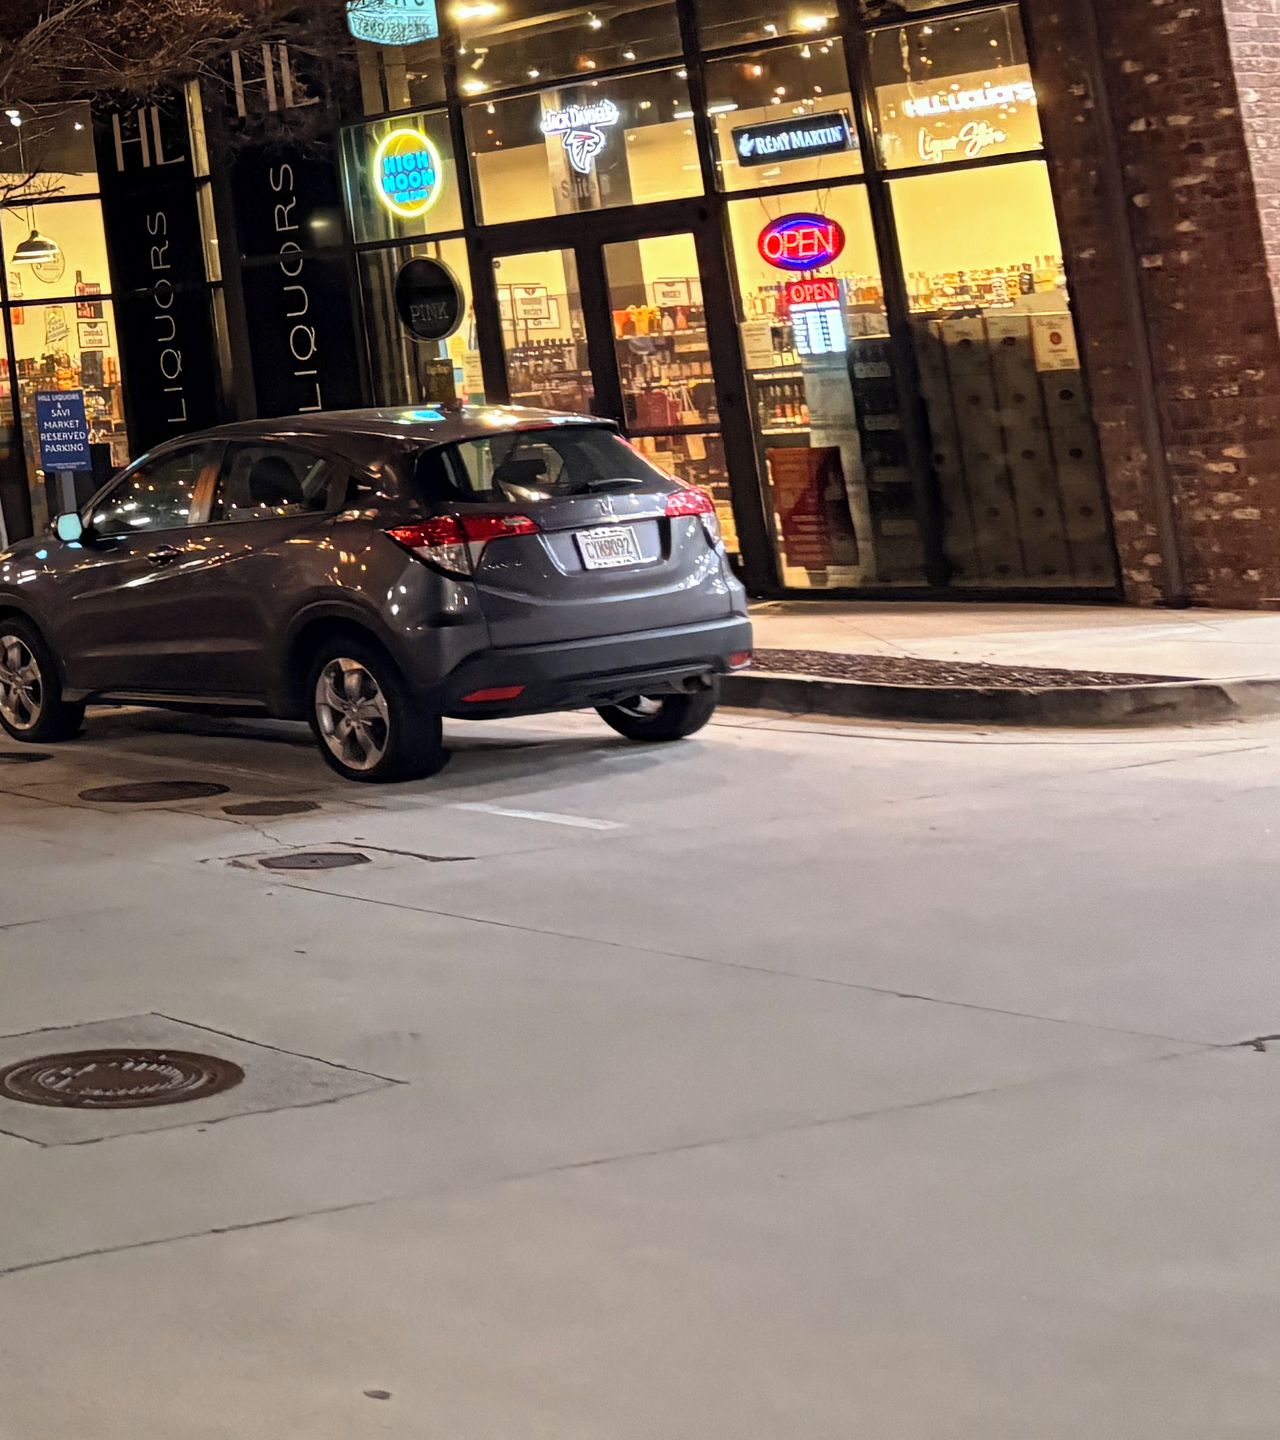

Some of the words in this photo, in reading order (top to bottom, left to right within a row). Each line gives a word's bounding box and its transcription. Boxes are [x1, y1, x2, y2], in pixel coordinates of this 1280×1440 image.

[112, 105, 185, 172] HL
[789, 125, 842, 149] MARTIN
[383, 150, 429, 175] HIGH
[382, 168, 435, 193] NOON
[763, 224, 835, 259] OPEN
[270, 163, 322, 412] LIQUORS
[791, 281, 837, 303] OPEN
[147, 211, 187, 422] LIQUORS
[44, 420, 79, 429] MARKET
[51, 409, 70, 417] SAVI
[41, 431, 86, 441] RESERVED
[45, 443, 84, 452] PARKING
